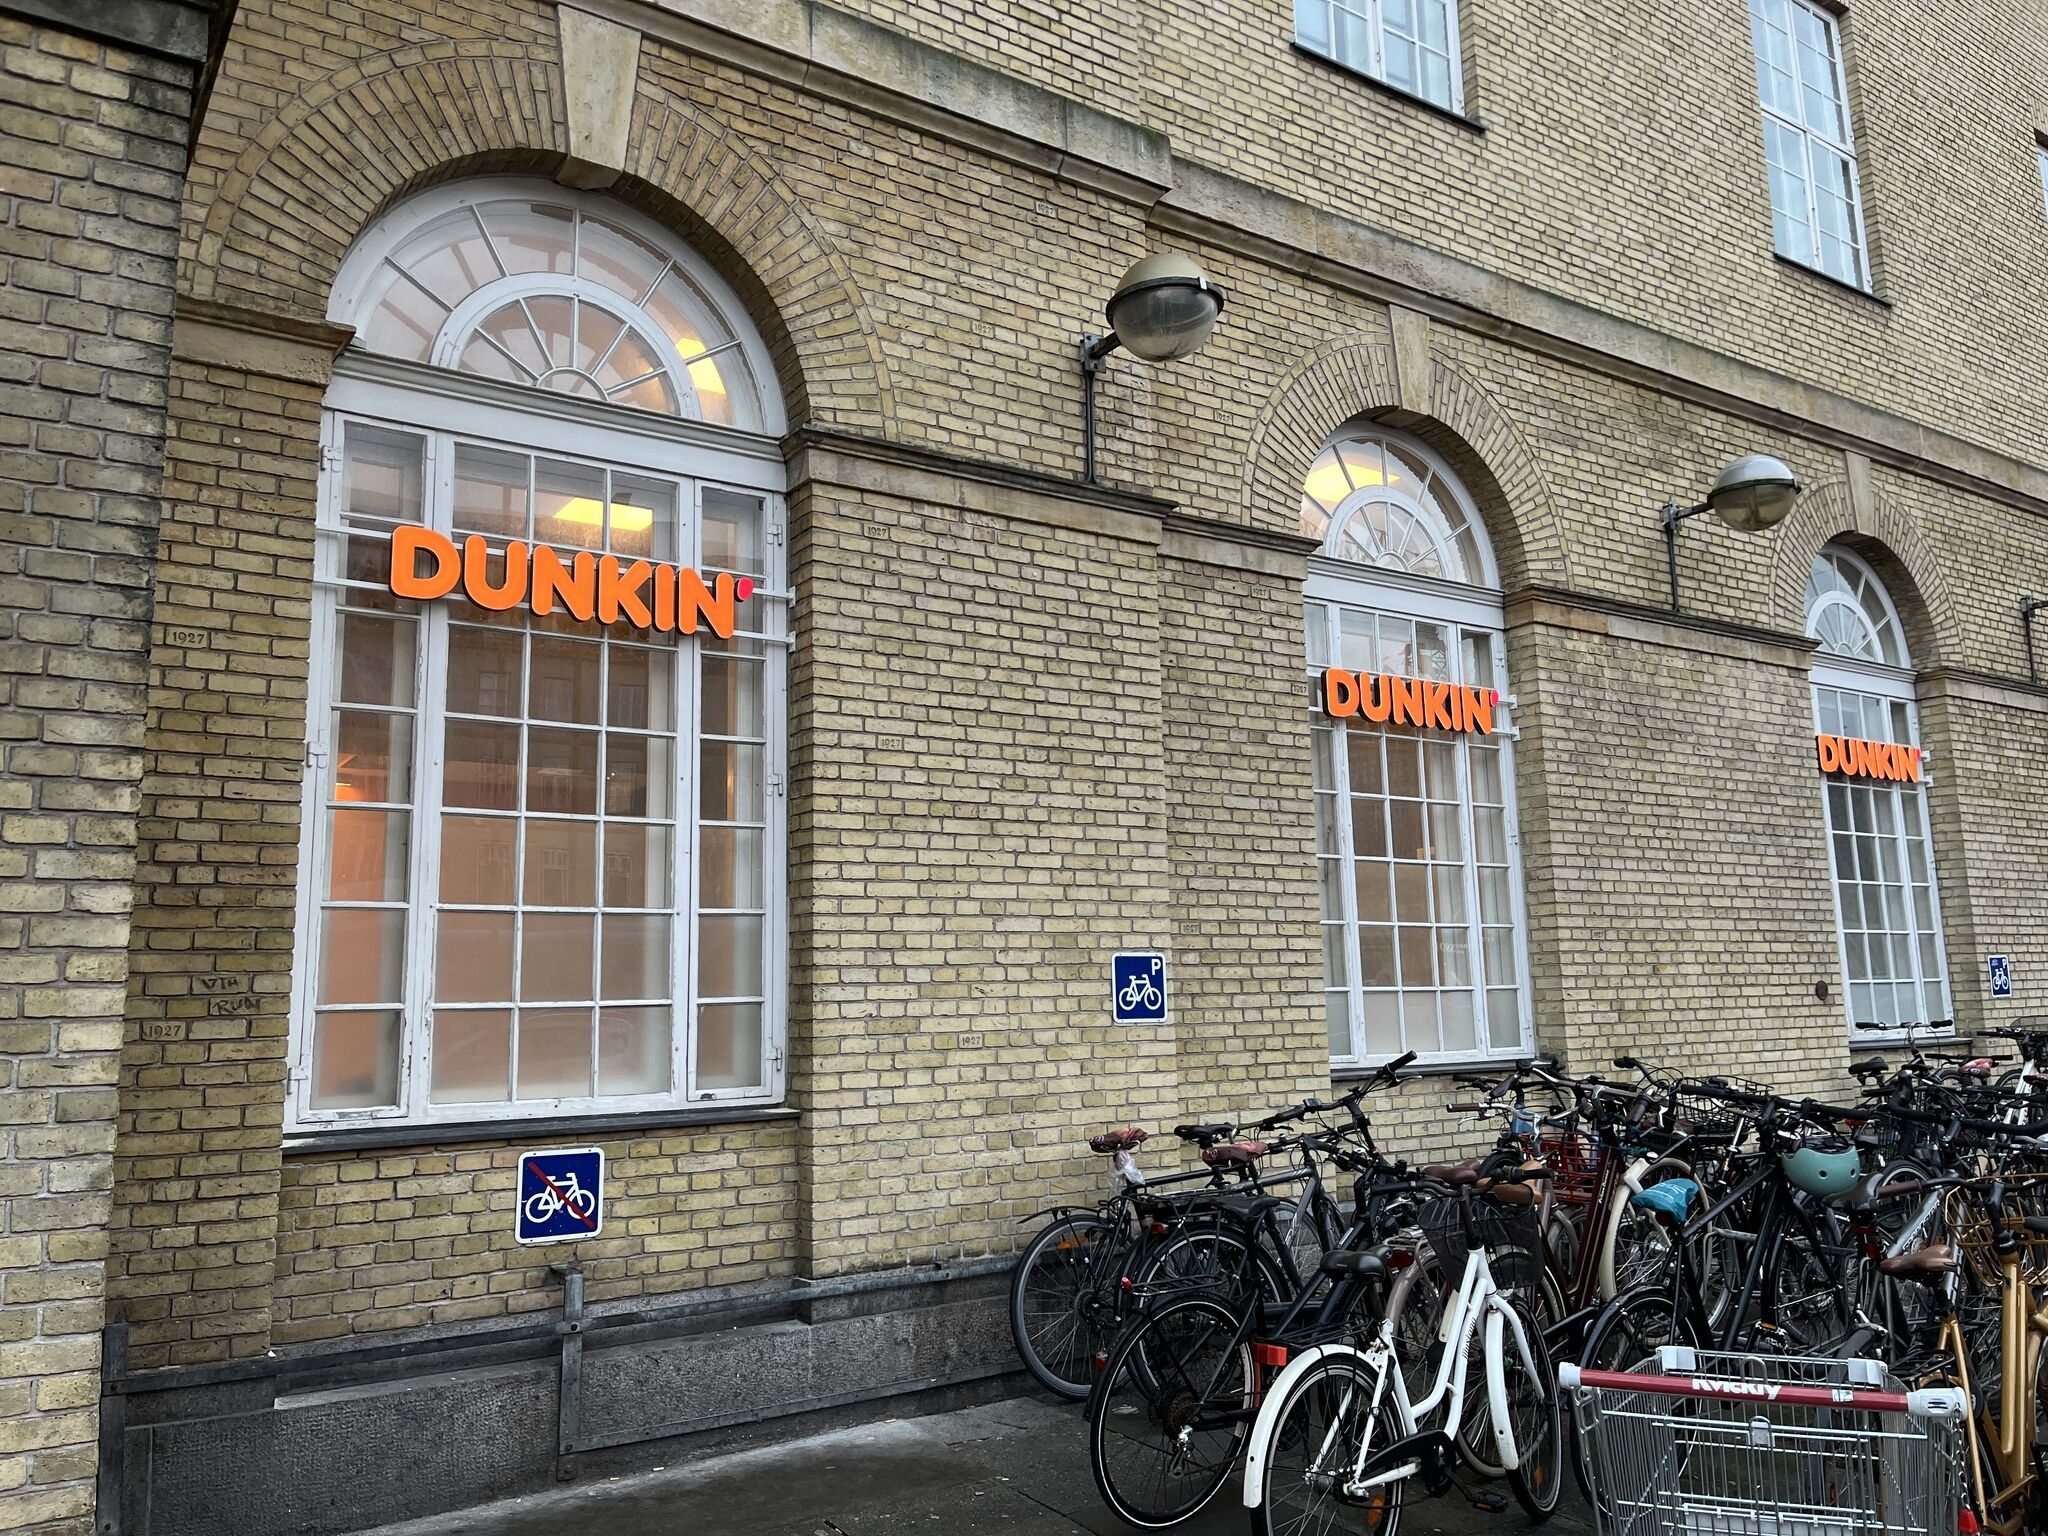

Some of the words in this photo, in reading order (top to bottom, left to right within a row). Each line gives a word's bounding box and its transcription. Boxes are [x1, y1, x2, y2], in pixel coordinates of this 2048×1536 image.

[1038, 203, 1056, 215] 1927
[974, 323, 992, 334] 1927
[1216, 412, 1231, 423] 1927
[868, 525, 888, 537] 1927
[390, 525, 754, 640] DUNKIN'
[1252, 586, 1267, 597] 1927
[172, 631, 205, 645] 1927
[1293, 684, 1307, 694] 1927
[1325, 667, 1499, 736] DUNKIN'
[881, 738, 902, 749] 1927
[1817, 733, 1921, 784] DUNKIN'
[1151, 959, 1162, 976] P
[2002, 958, 2008, 969] P
[148, 1024, 182, 1039] 1927
[962, 1036, 981, 1046] 1927
